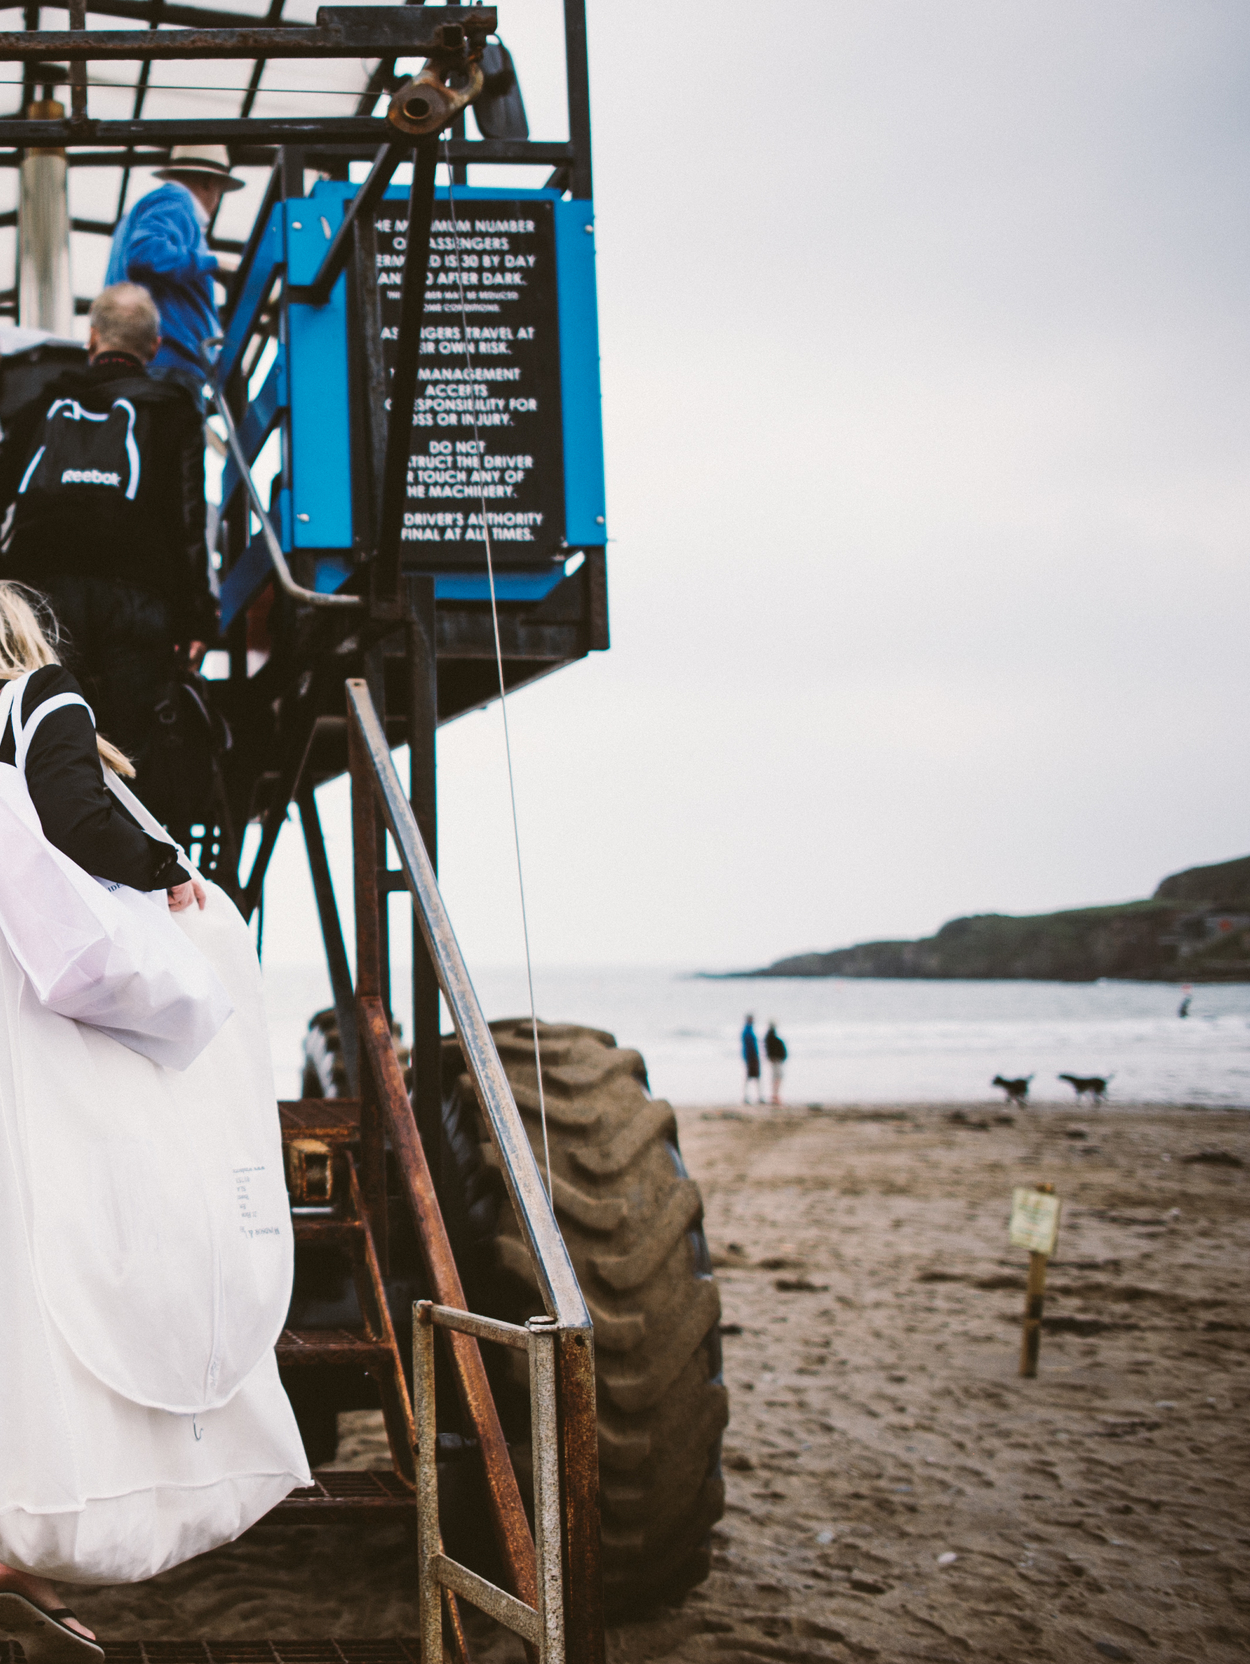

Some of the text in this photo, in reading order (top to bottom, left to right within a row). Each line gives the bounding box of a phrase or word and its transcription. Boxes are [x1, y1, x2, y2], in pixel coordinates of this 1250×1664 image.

[375, 220, 392, 232] HE
[475, 220, 535, 232] NUMBER
[392, 237, 510, 250] O ASSENGERS
[444, 254, 458, 268] IS
[461, 254, 479, 268] 30
[482, 254, 501, 268] BY
[504, 254, 536, 268] DAY
[377, 272, 402, 285] AN
[436, 272, 479, 285] AFTER
[482, 272, 528, 286] DARK.
[466, 327, 514, 340] TRAVEL
[516, 327, 535, 340] AT
[438, 341, 475, 354] OWN
[478, 342, 512, 354] RISK.
[417, 368, 521, 380] MANAGEMENT
[424, 384, 488, 397] ACCEPTS
[509, 398, 537, 411] FOR
[436, 412, 458, 426] OR
[461, 413, 514, 426] INJURY.
[429, 441, 485, 454] DO NOT
[408, 455, 534, 468] TRUCT THE DRIVER
[61, 470, 121, 487] Reebok
[406, 470, 525, 483] R TOUCH ANY OF
[406, 485, 518, 498] HE MACHINERY.
[403, 513, 543, 526] DRIVER'S AUTHORITY
[401, 528, 535, 540] FINAL AT ALL TIMES.
